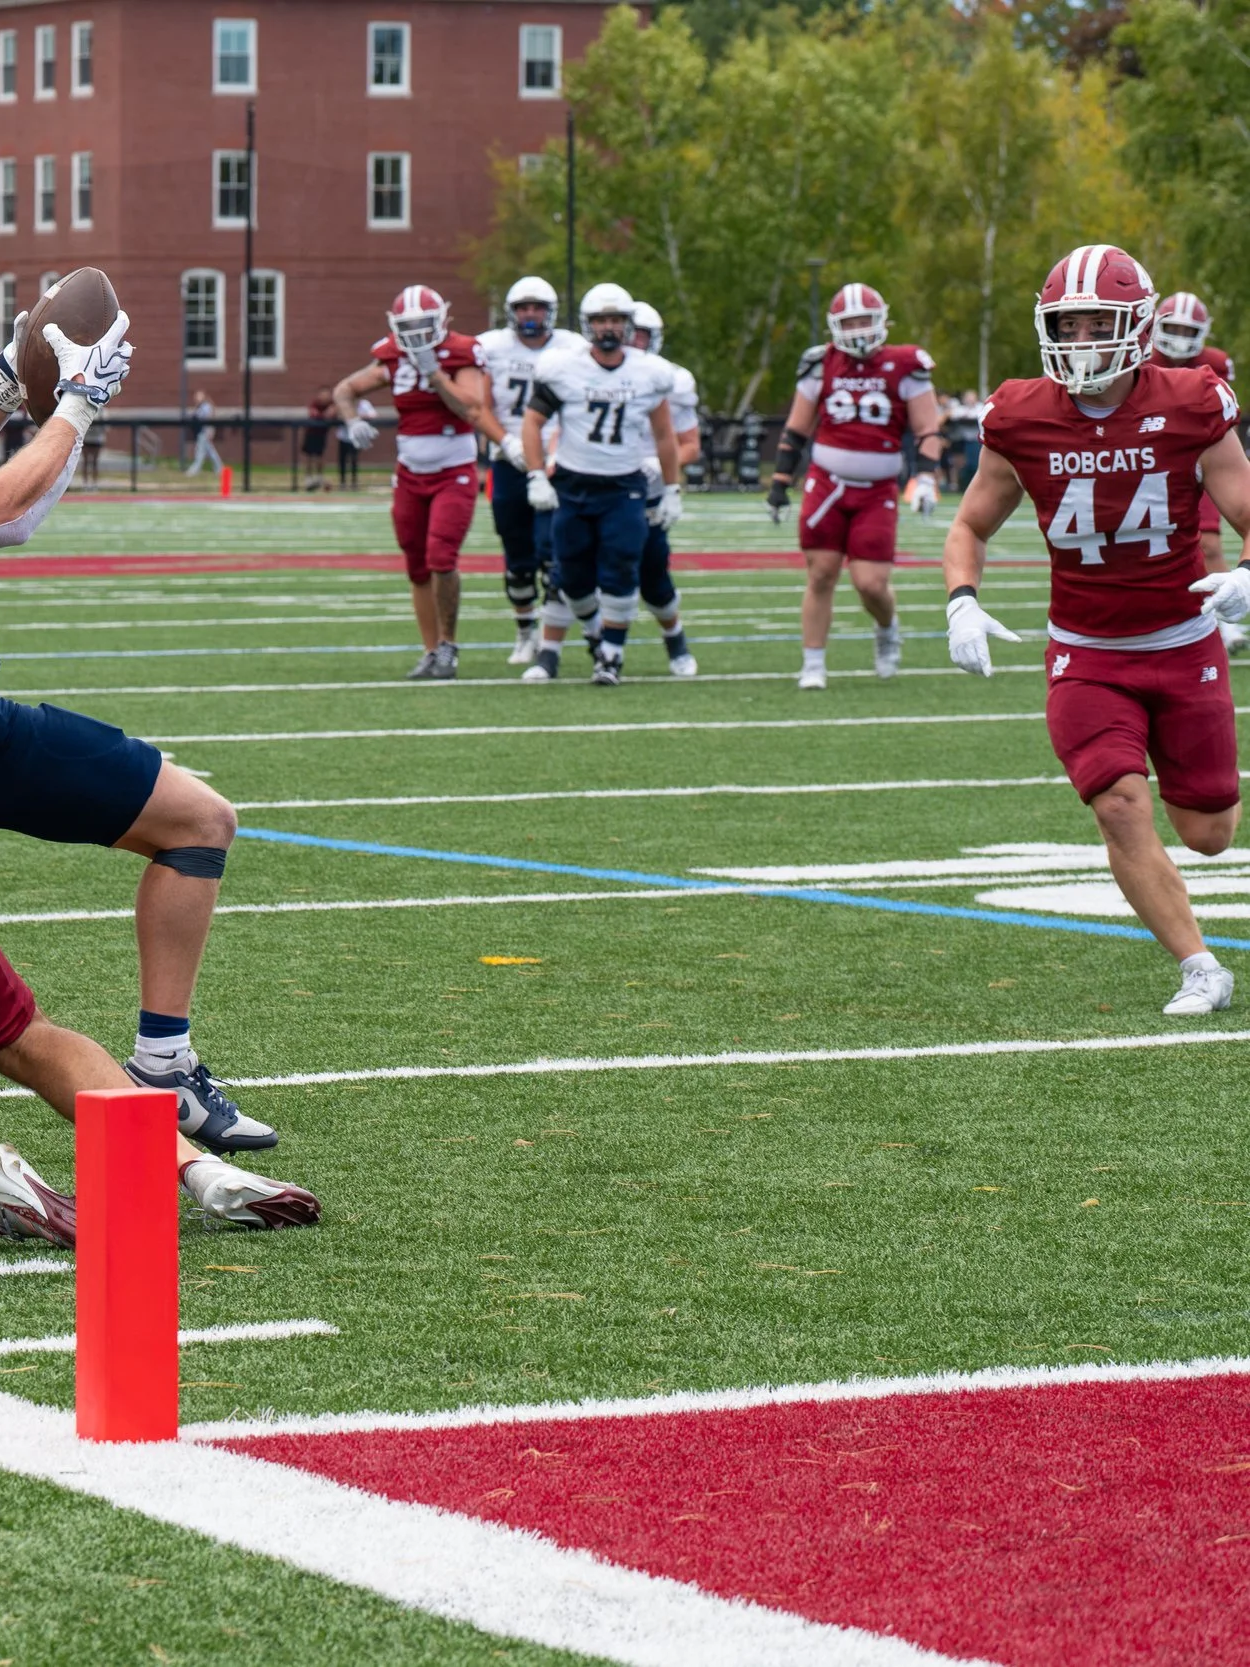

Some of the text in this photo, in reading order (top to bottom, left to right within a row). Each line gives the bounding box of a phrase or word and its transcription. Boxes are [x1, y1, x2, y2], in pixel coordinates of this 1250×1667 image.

[587, 400, 626, 444] 71
[1048, 447, 1156, 476] BOBCATS
[1047, 470, 1178, 565] 44
